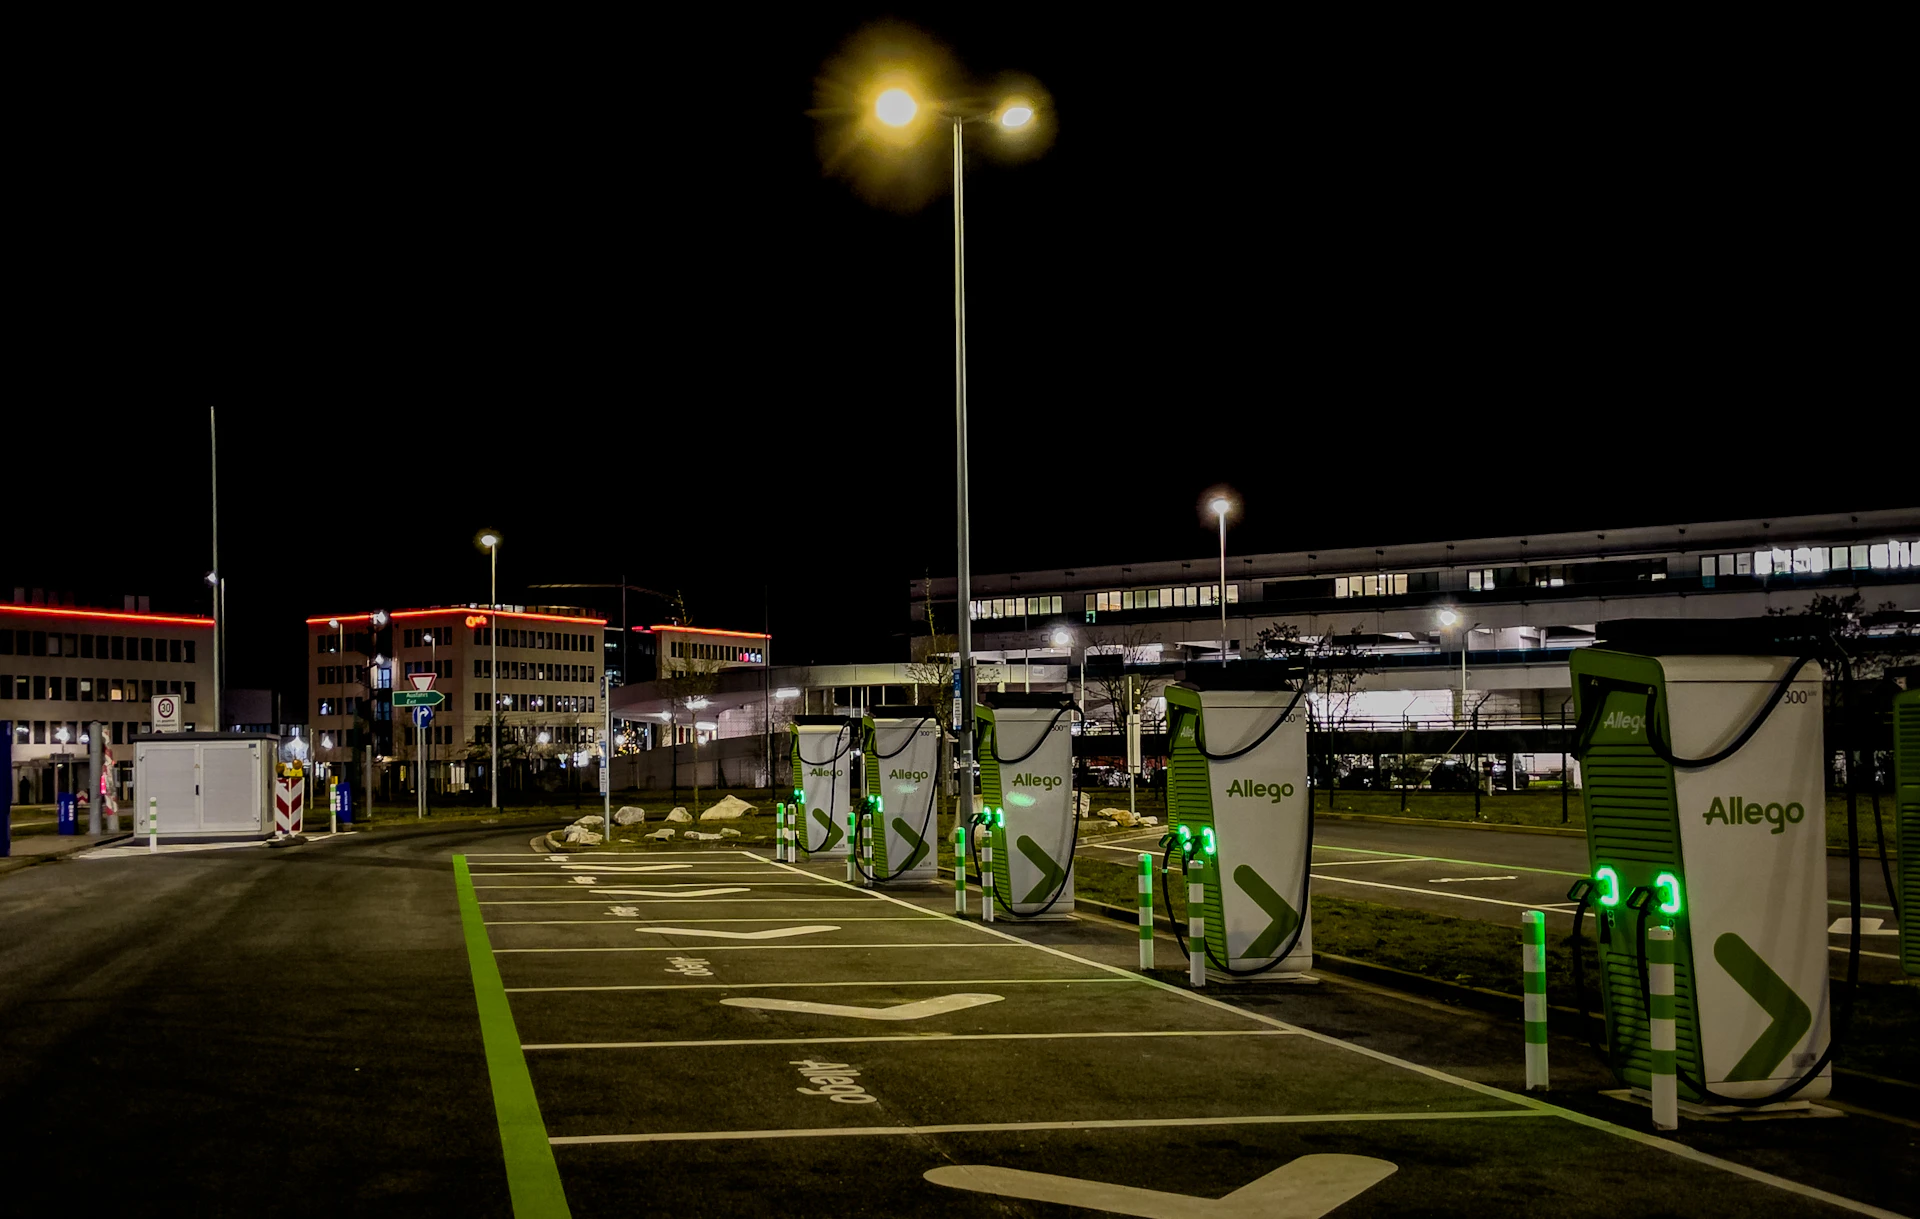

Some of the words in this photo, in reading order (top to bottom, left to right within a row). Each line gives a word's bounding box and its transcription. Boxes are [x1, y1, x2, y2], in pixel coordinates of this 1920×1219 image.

[161, 703, 171, 713] 30
[889, 769, 929, 783] Allego
[1012, 773, 1062, 791] Allego
[1227, 779, 1295, 804] Allego
[1702, 796, 1804, 835] Allego
[788, 1059, 878, 1104] Allego
